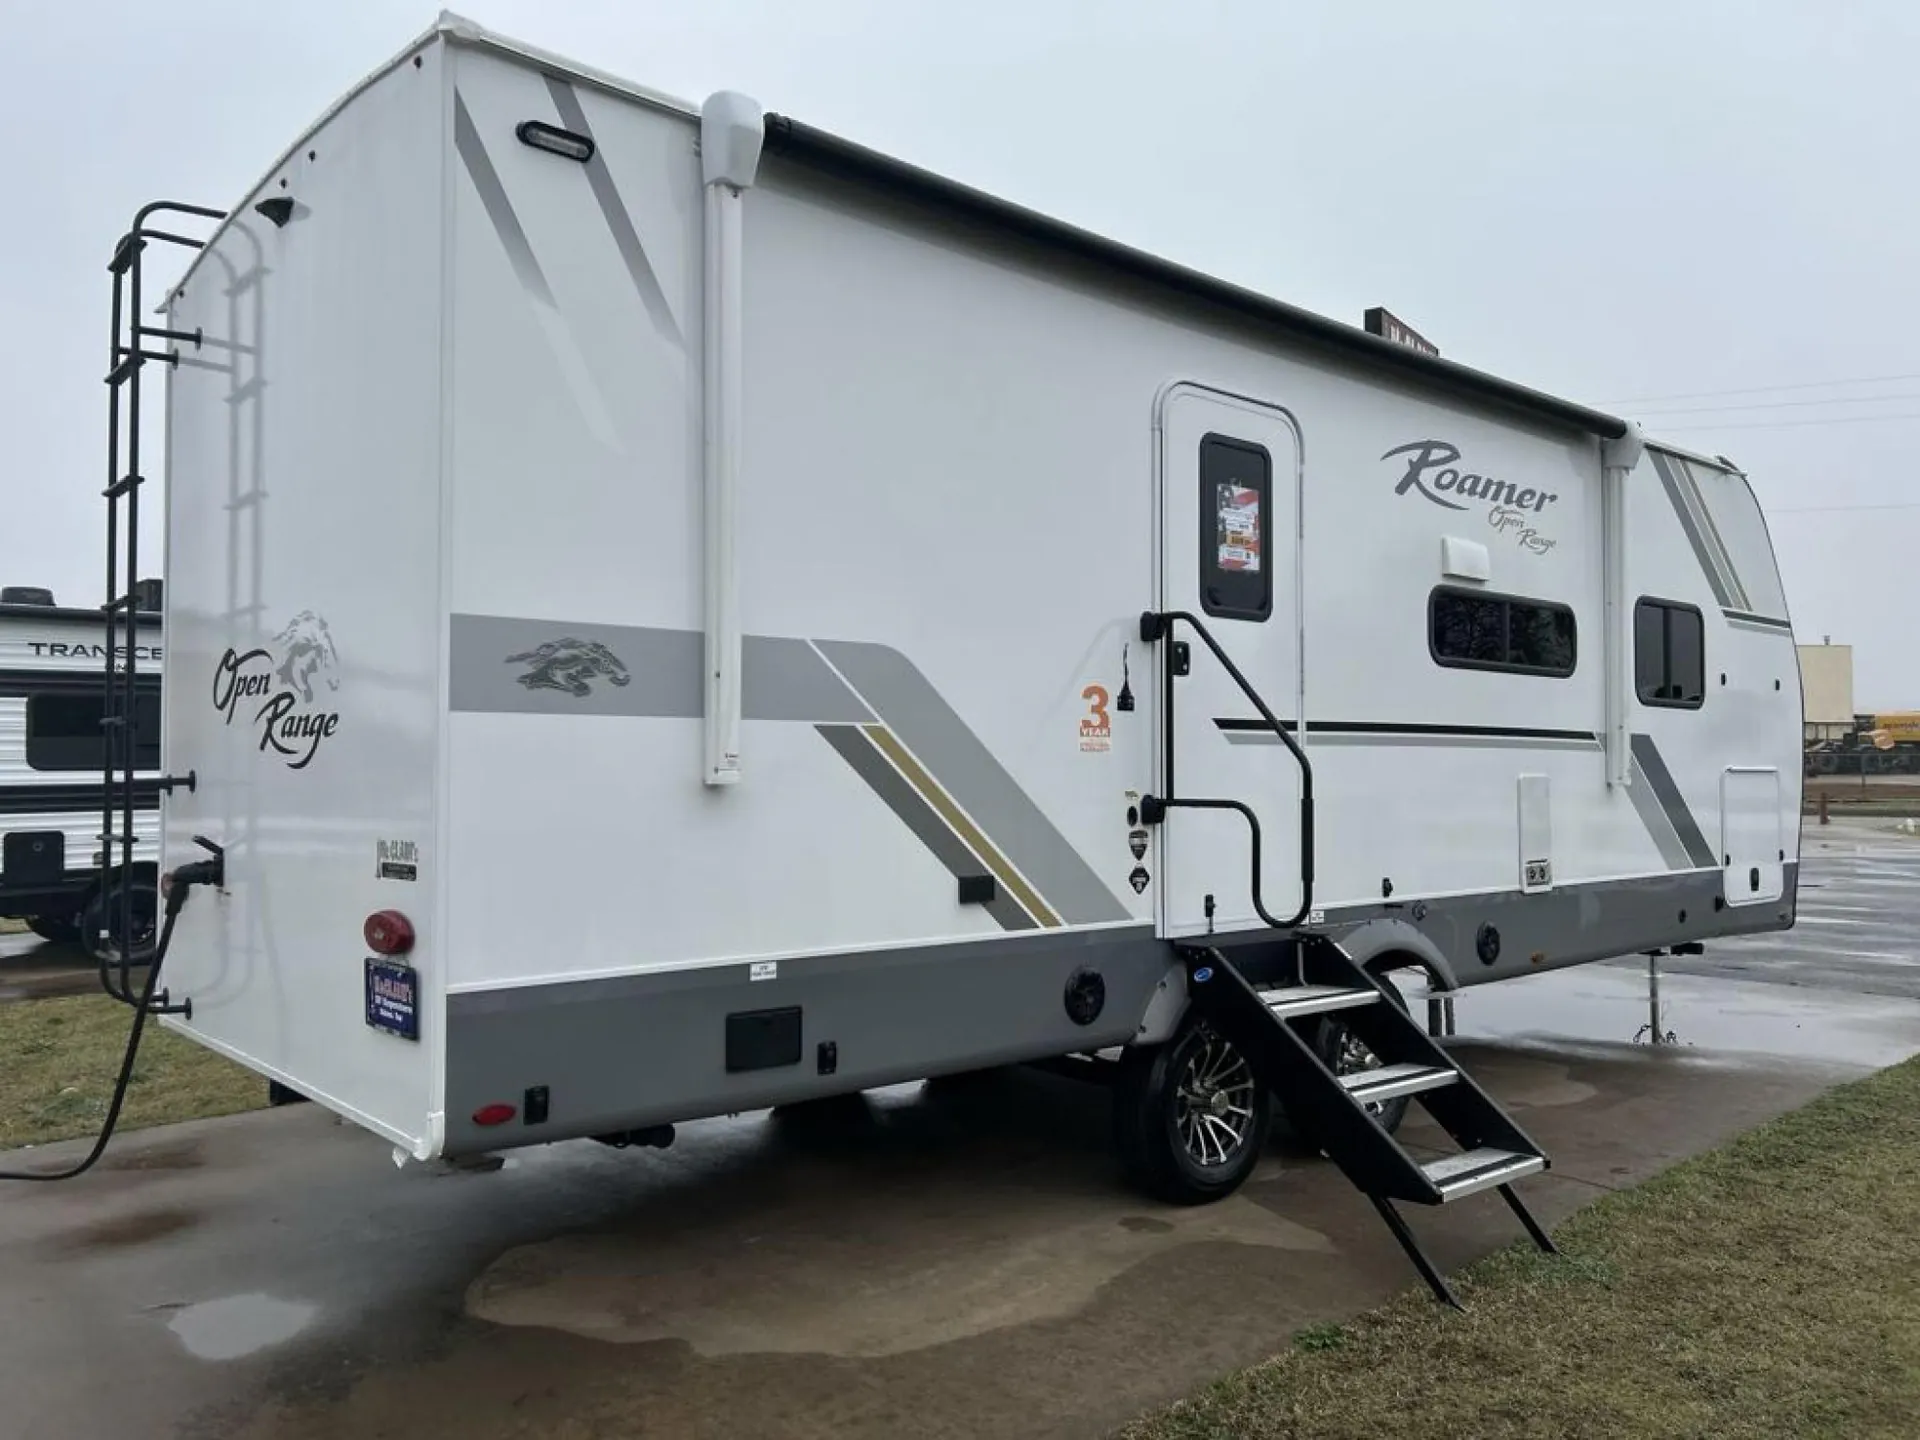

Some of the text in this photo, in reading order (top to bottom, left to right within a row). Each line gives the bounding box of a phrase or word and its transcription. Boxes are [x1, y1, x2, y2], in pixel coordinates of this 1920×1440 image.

[1380, 440, 1558, 511] Roamer
[1488, 506, 1525, 532] Open
[1517, 528, 1557, 555] Range
[213, 648, 274, 725] Open
[1081, 685, 1109, 728] 3
[253, 691, 339, 769] Range
